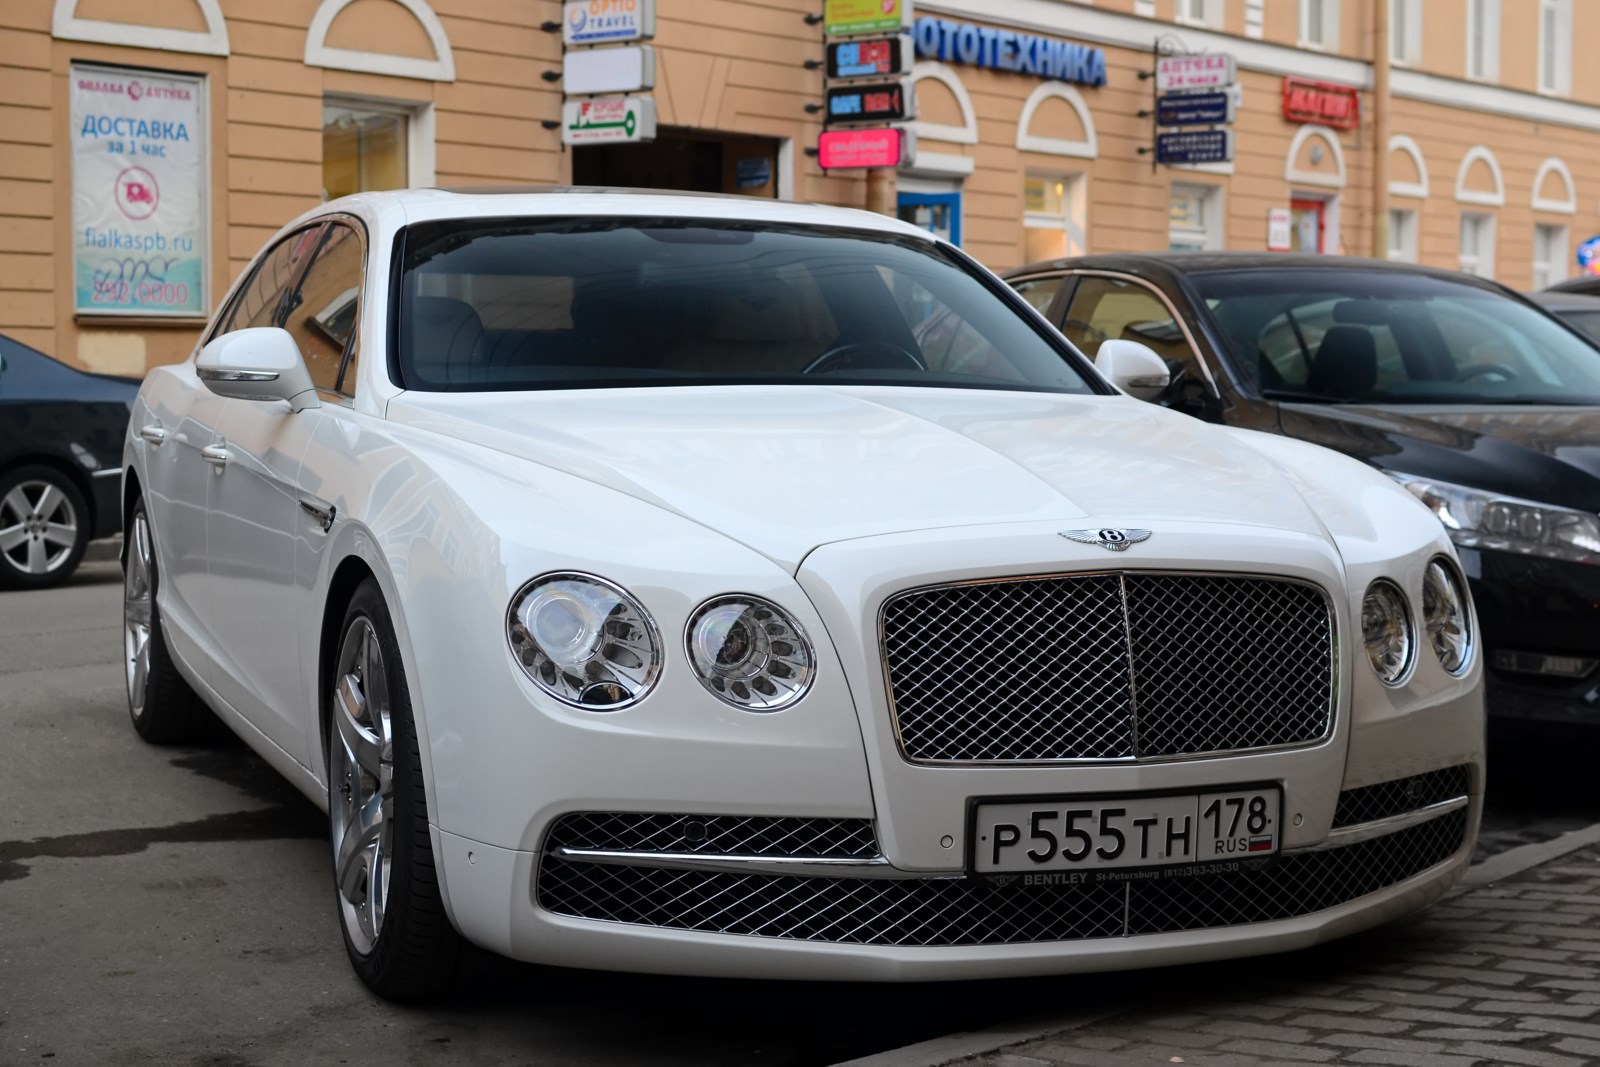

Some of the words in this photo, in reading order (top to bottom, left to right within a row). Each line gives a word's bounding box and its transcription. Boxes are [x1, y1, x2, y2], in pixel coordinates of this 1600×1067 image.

[590, 16, 634, 28] TRAVEL
[912, 15, 1107, 86] ОТОТЕХНИКА
[1168, 77, 1183, 87] 24
[82, 114, 189, 142] ДОСТАВКА
[108, 141, 123, 153] за
[130, 141, 136, 155] 1
[141, 144, 167, 157] час
[85, 226, 193, 254] fialkaspb.ru
[1203, 796, 1268, 838] 178
[1215, 838, 1248, 854] RUS
[1024, 872, 1088, 886] BENTLEY
[1096, 871, 1159, 881] St-Petersburg
